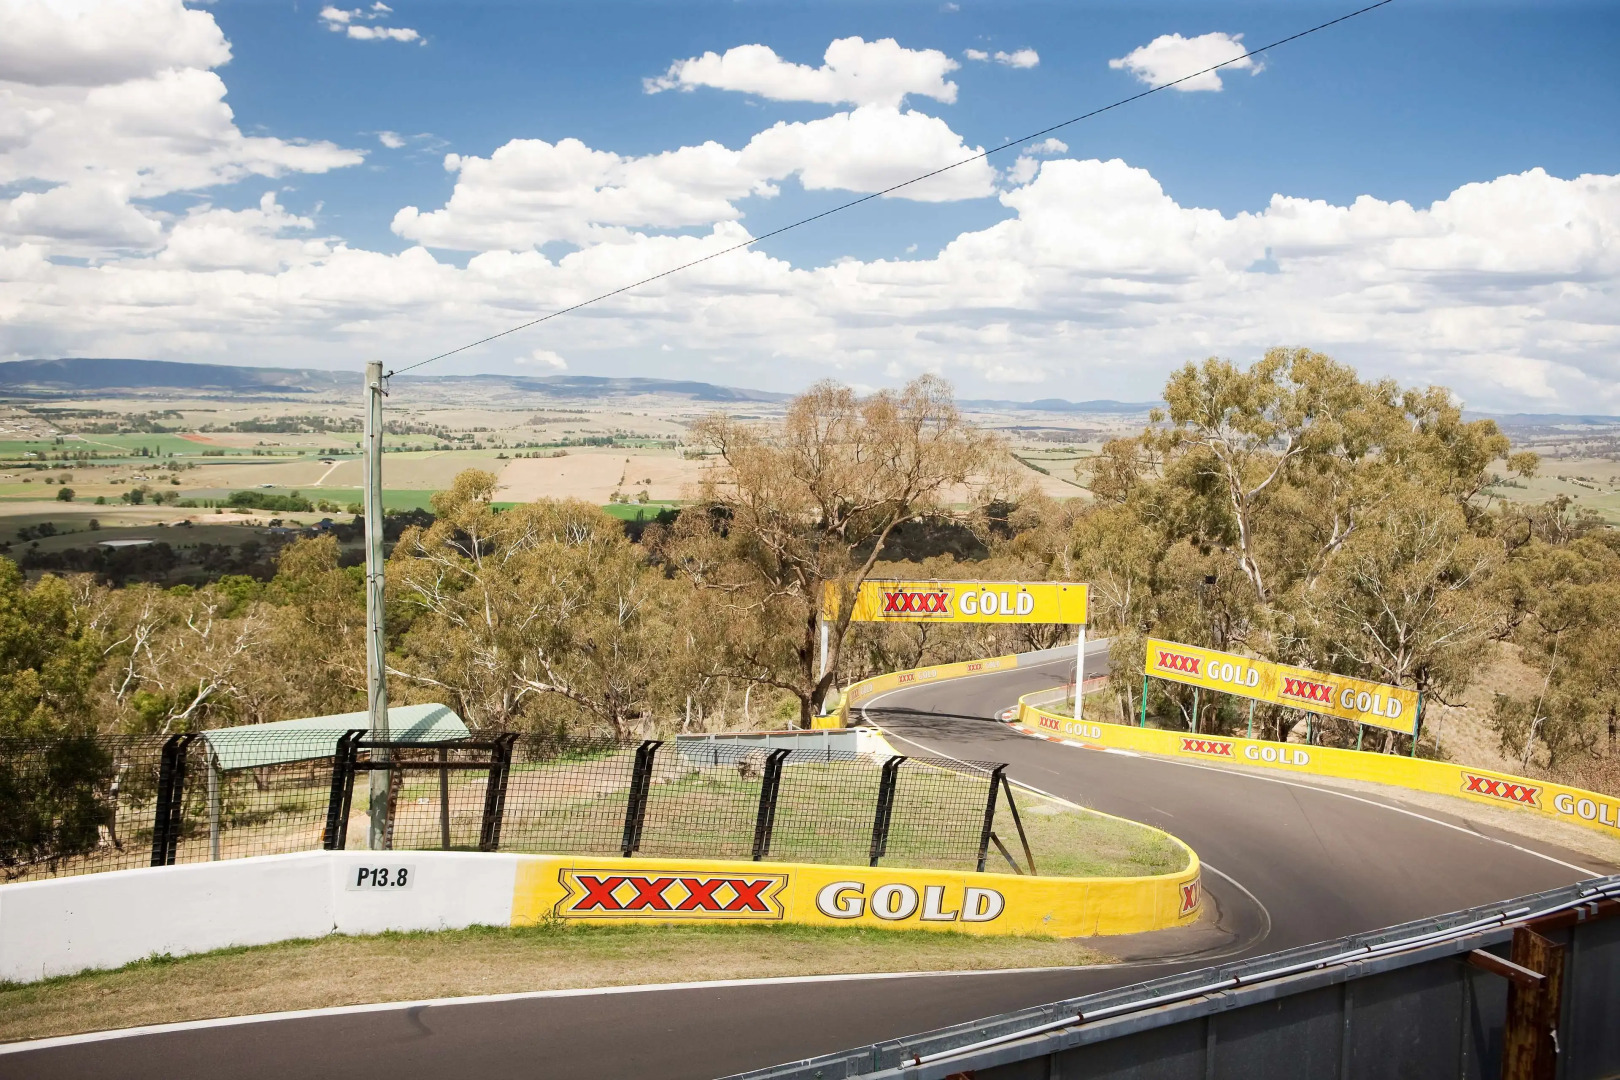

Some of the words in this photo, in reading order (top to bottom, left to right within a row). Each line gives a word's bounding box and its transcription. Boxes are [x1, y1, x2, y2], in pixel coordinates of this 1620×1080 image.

[884, 592, 948, 613] XXXX
[959, 591, 1034, 615] GOLD
[1159, 651, 1201, 675] XXXX
[1207, 660, 1259, 687] GOLD
[1282, 677, 1333, 703] XXXX
[1340, 688, 1403, 719] GOLD
[1039, 715, 1060, 731] XXXX
[1065, 721, 1102, 739] GOLD
[1181, 738, 1232, 756] XXXX
[1243, 744, 1310, 766] GOLD
[1467, 775, 1537, 805] XXXX
[1553, 793, 1620, 830] GOL
[356, 867, 408, 887] P13.8
[571, 876, 776, 912] XXXX
[815, 880, 1006, 923] GOLD
